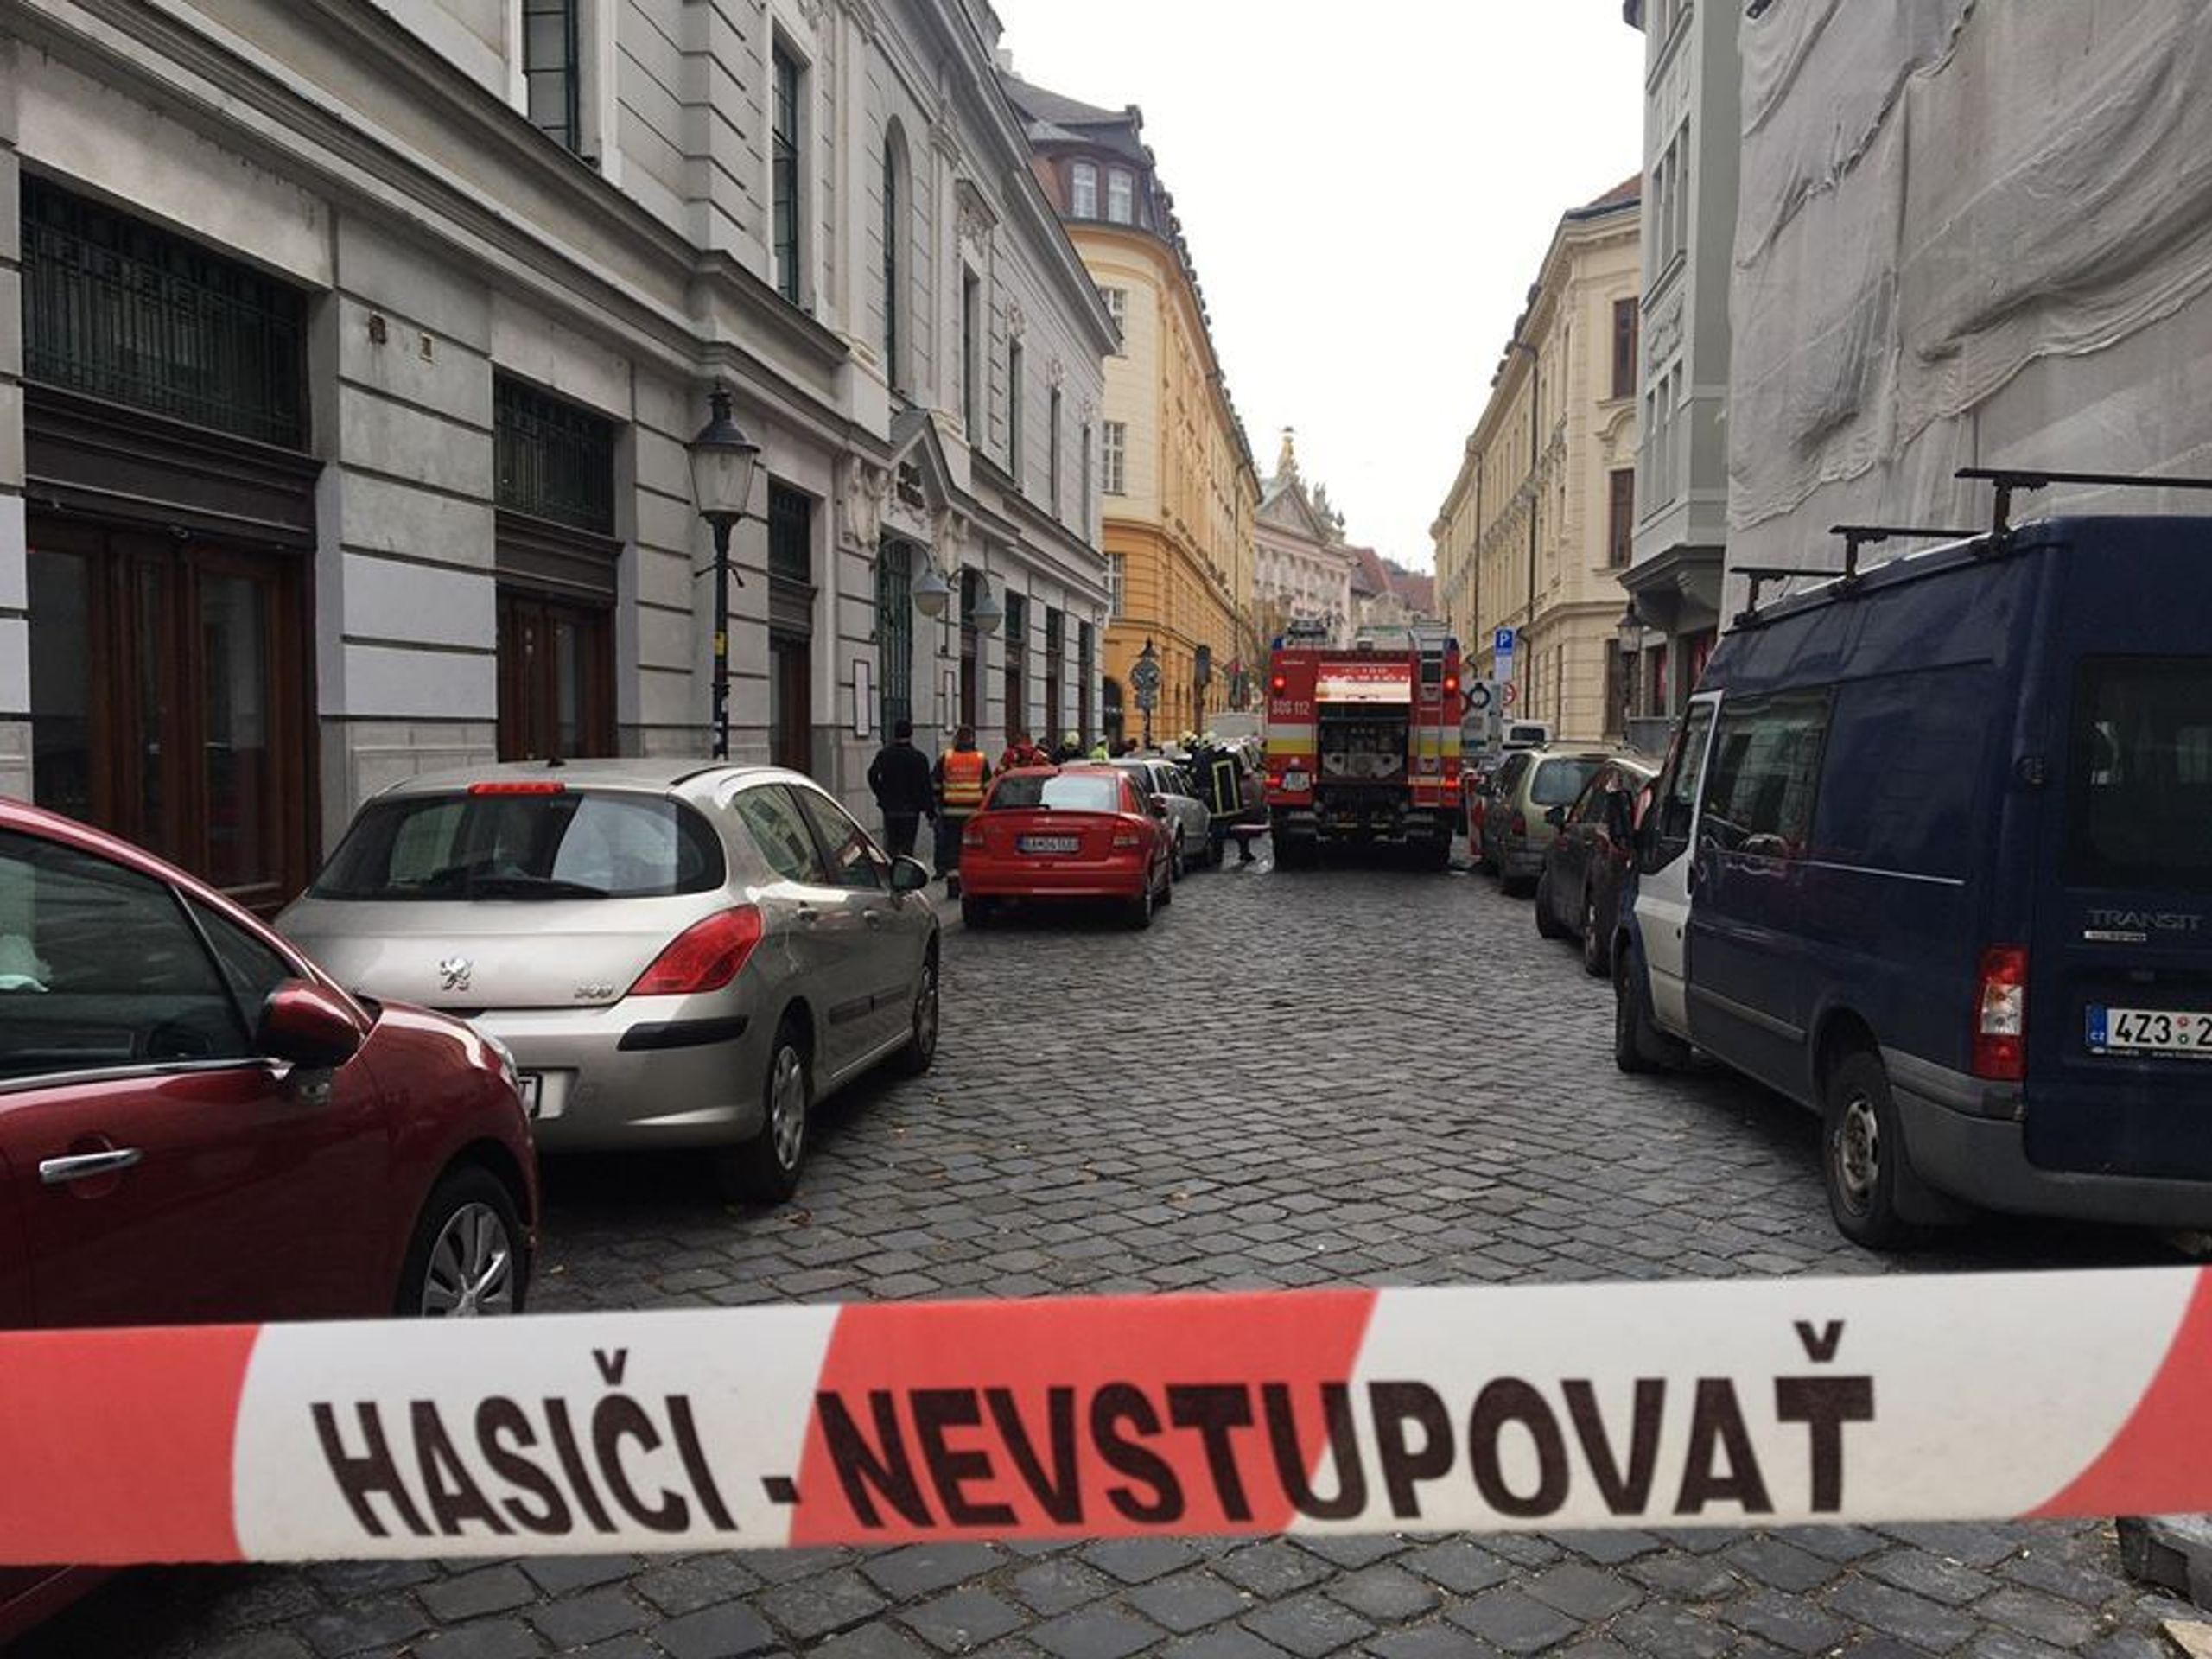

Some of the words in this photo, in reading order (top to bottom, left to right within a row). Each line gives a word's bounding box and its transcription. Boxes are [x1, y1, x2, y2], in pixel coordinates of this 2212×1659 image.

[1294, 700, 1310, 716] 112
[2086, 909, 2203, 930] TRANSIT
[2115, 1014, 2171, 1044] 4Z3
[312, 1348, 737, 1537] HASIČI
[815, 1320, 1874, 1529] NEVSTUPOVAŤ
